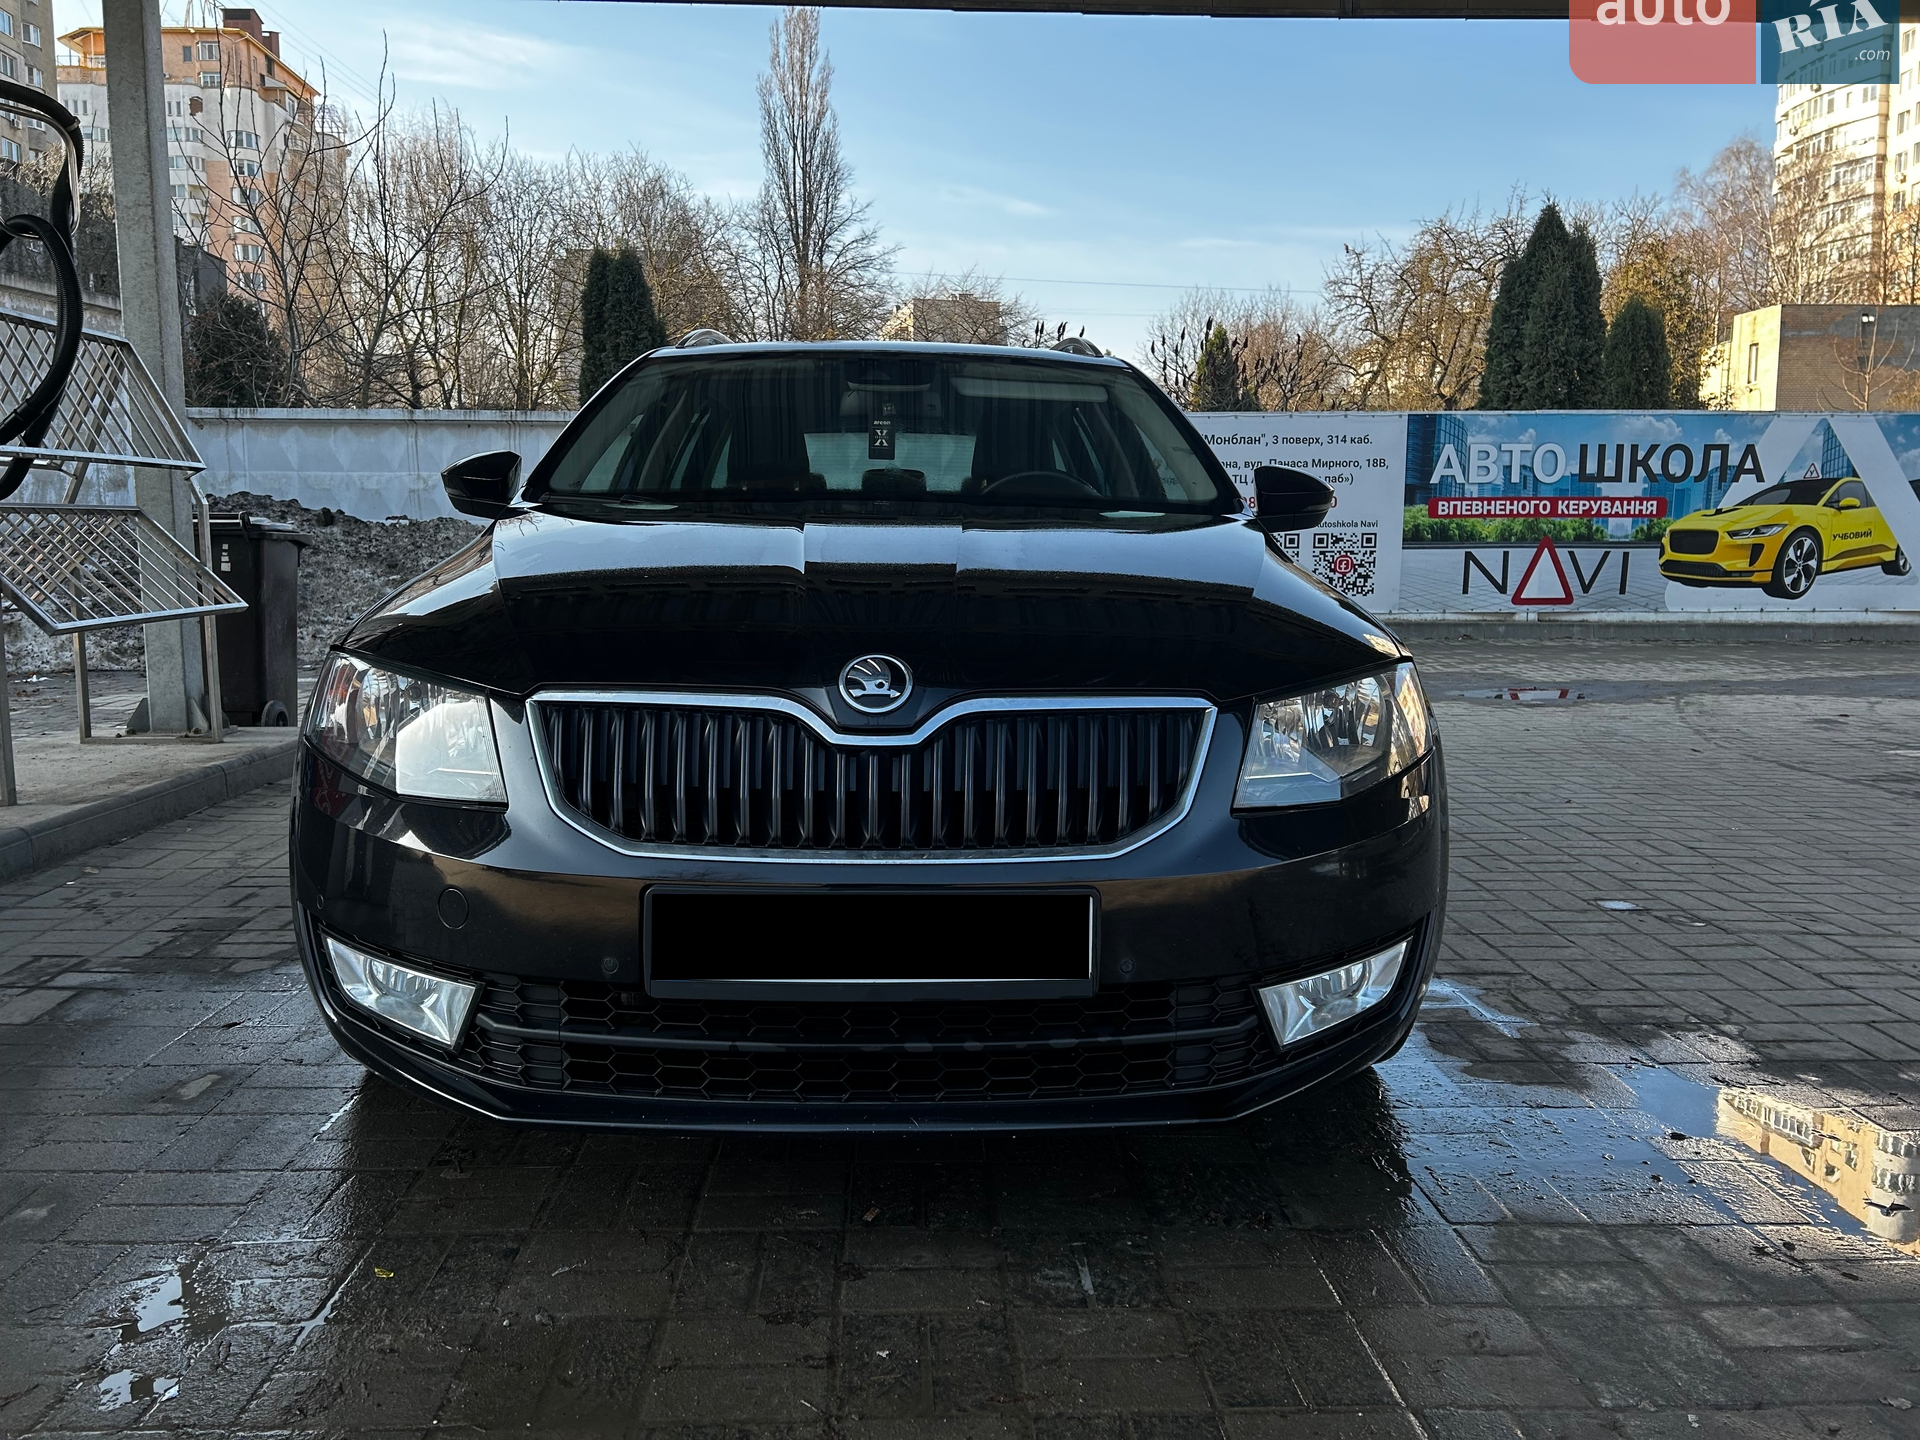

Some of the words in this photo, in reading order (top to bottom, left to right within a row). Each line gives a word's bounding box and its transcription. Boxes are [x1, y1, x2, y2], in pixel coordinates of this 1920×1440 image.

[1272, 435, 1279, 444] 3
[1282, 437, 1323, 447] поверх,
[1327, 434, 1347, 444] 314
[1350, 434, 1373, 445] каб.
[1269, 458, 1309, 468] Панаса
[1311, 458, 1362, 470] Мирного,
[1429, 443, 1567, 484] АВТО
[1578, 443, 1765, 483] ШКОЛА
[1437, 500, 1551, 516] ВПЕВНЕНОГО
[1557, 500, 1657, 515] КЕРУВАННЯ
[1317, 520, 1358, 528] utoshkola
[1832, 529, 1872, 541] УЧБОВИЙ
